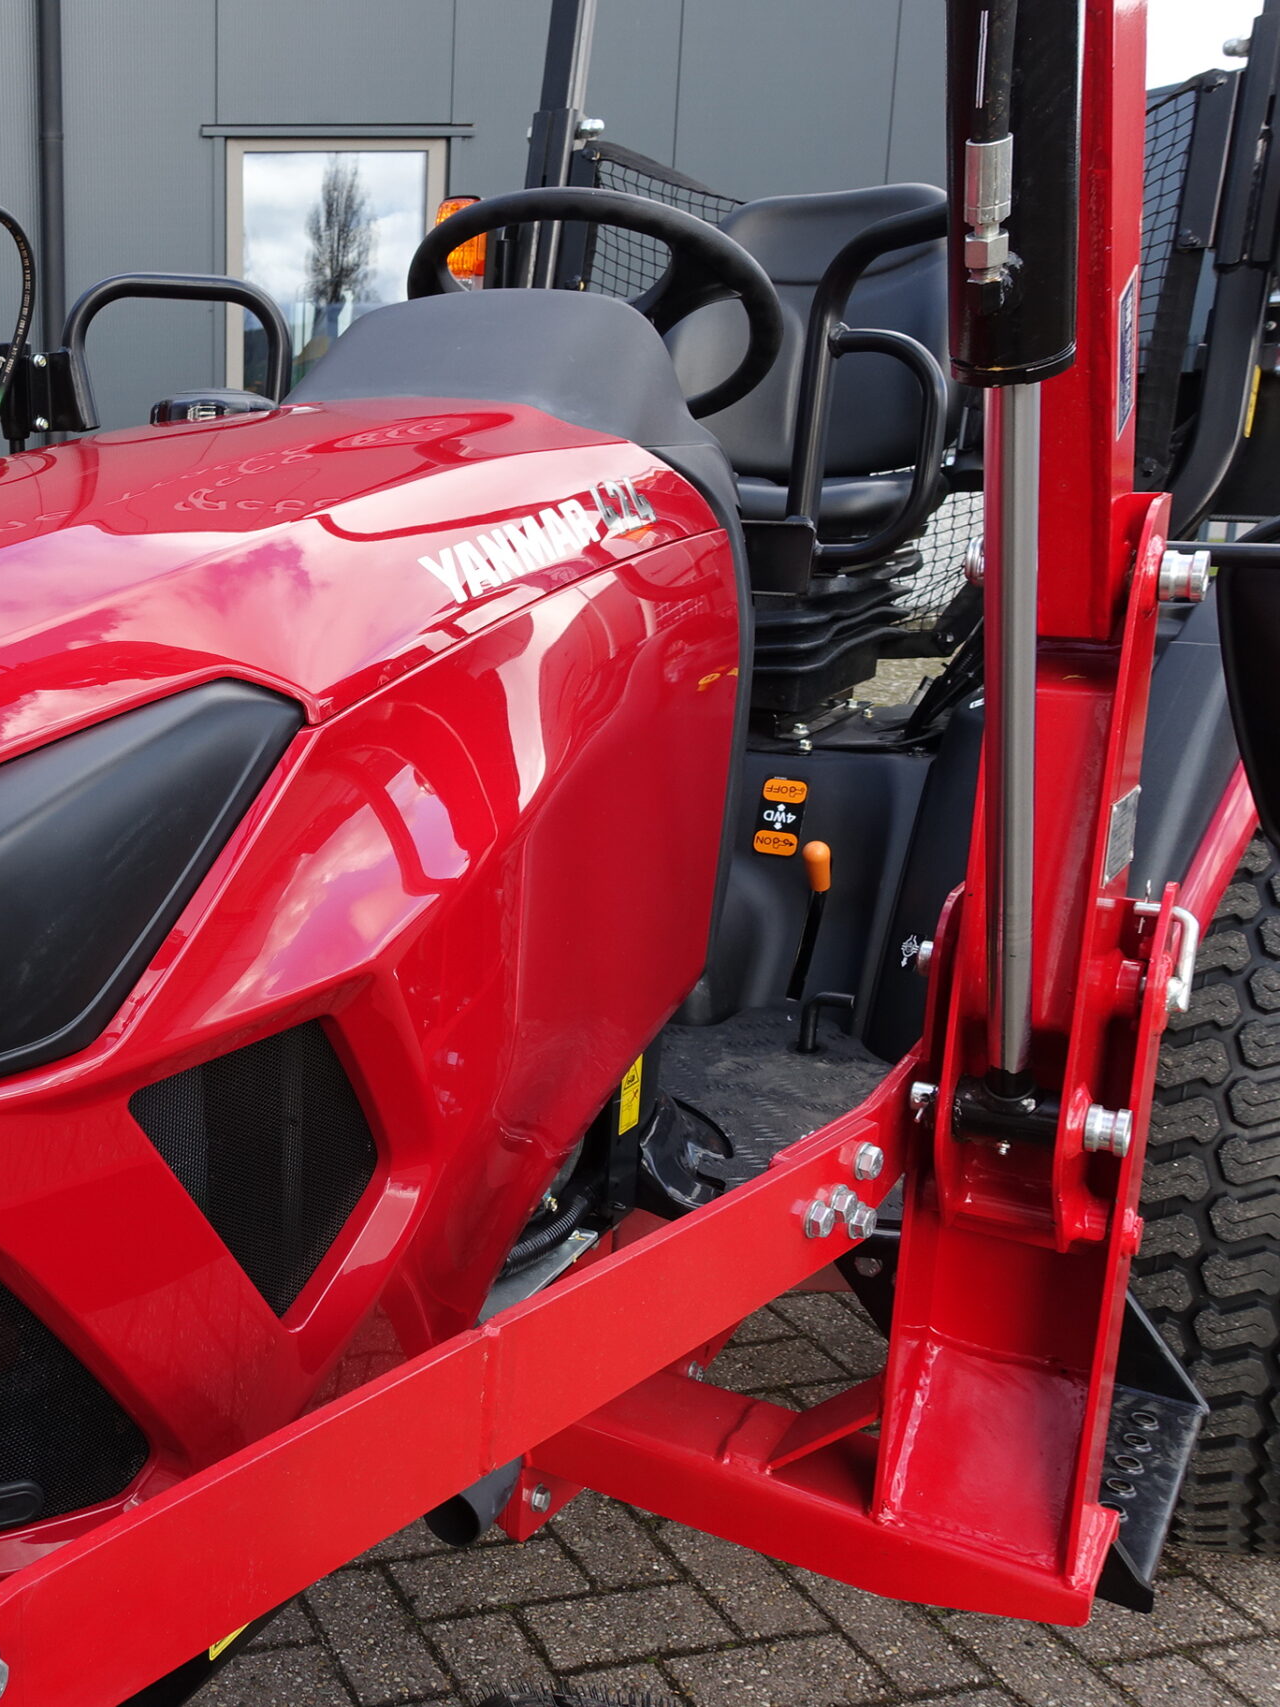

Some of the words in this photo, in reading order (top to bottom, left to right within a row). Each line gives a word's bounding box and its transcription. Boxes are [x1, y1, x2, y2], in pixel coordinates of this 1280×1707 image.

[418, 499, 600, 603] YANMAR
[765, 785, 788, 794] OFF
[763, 809, 796, 823] 4WD
[755, 836, 772, 845] ON
